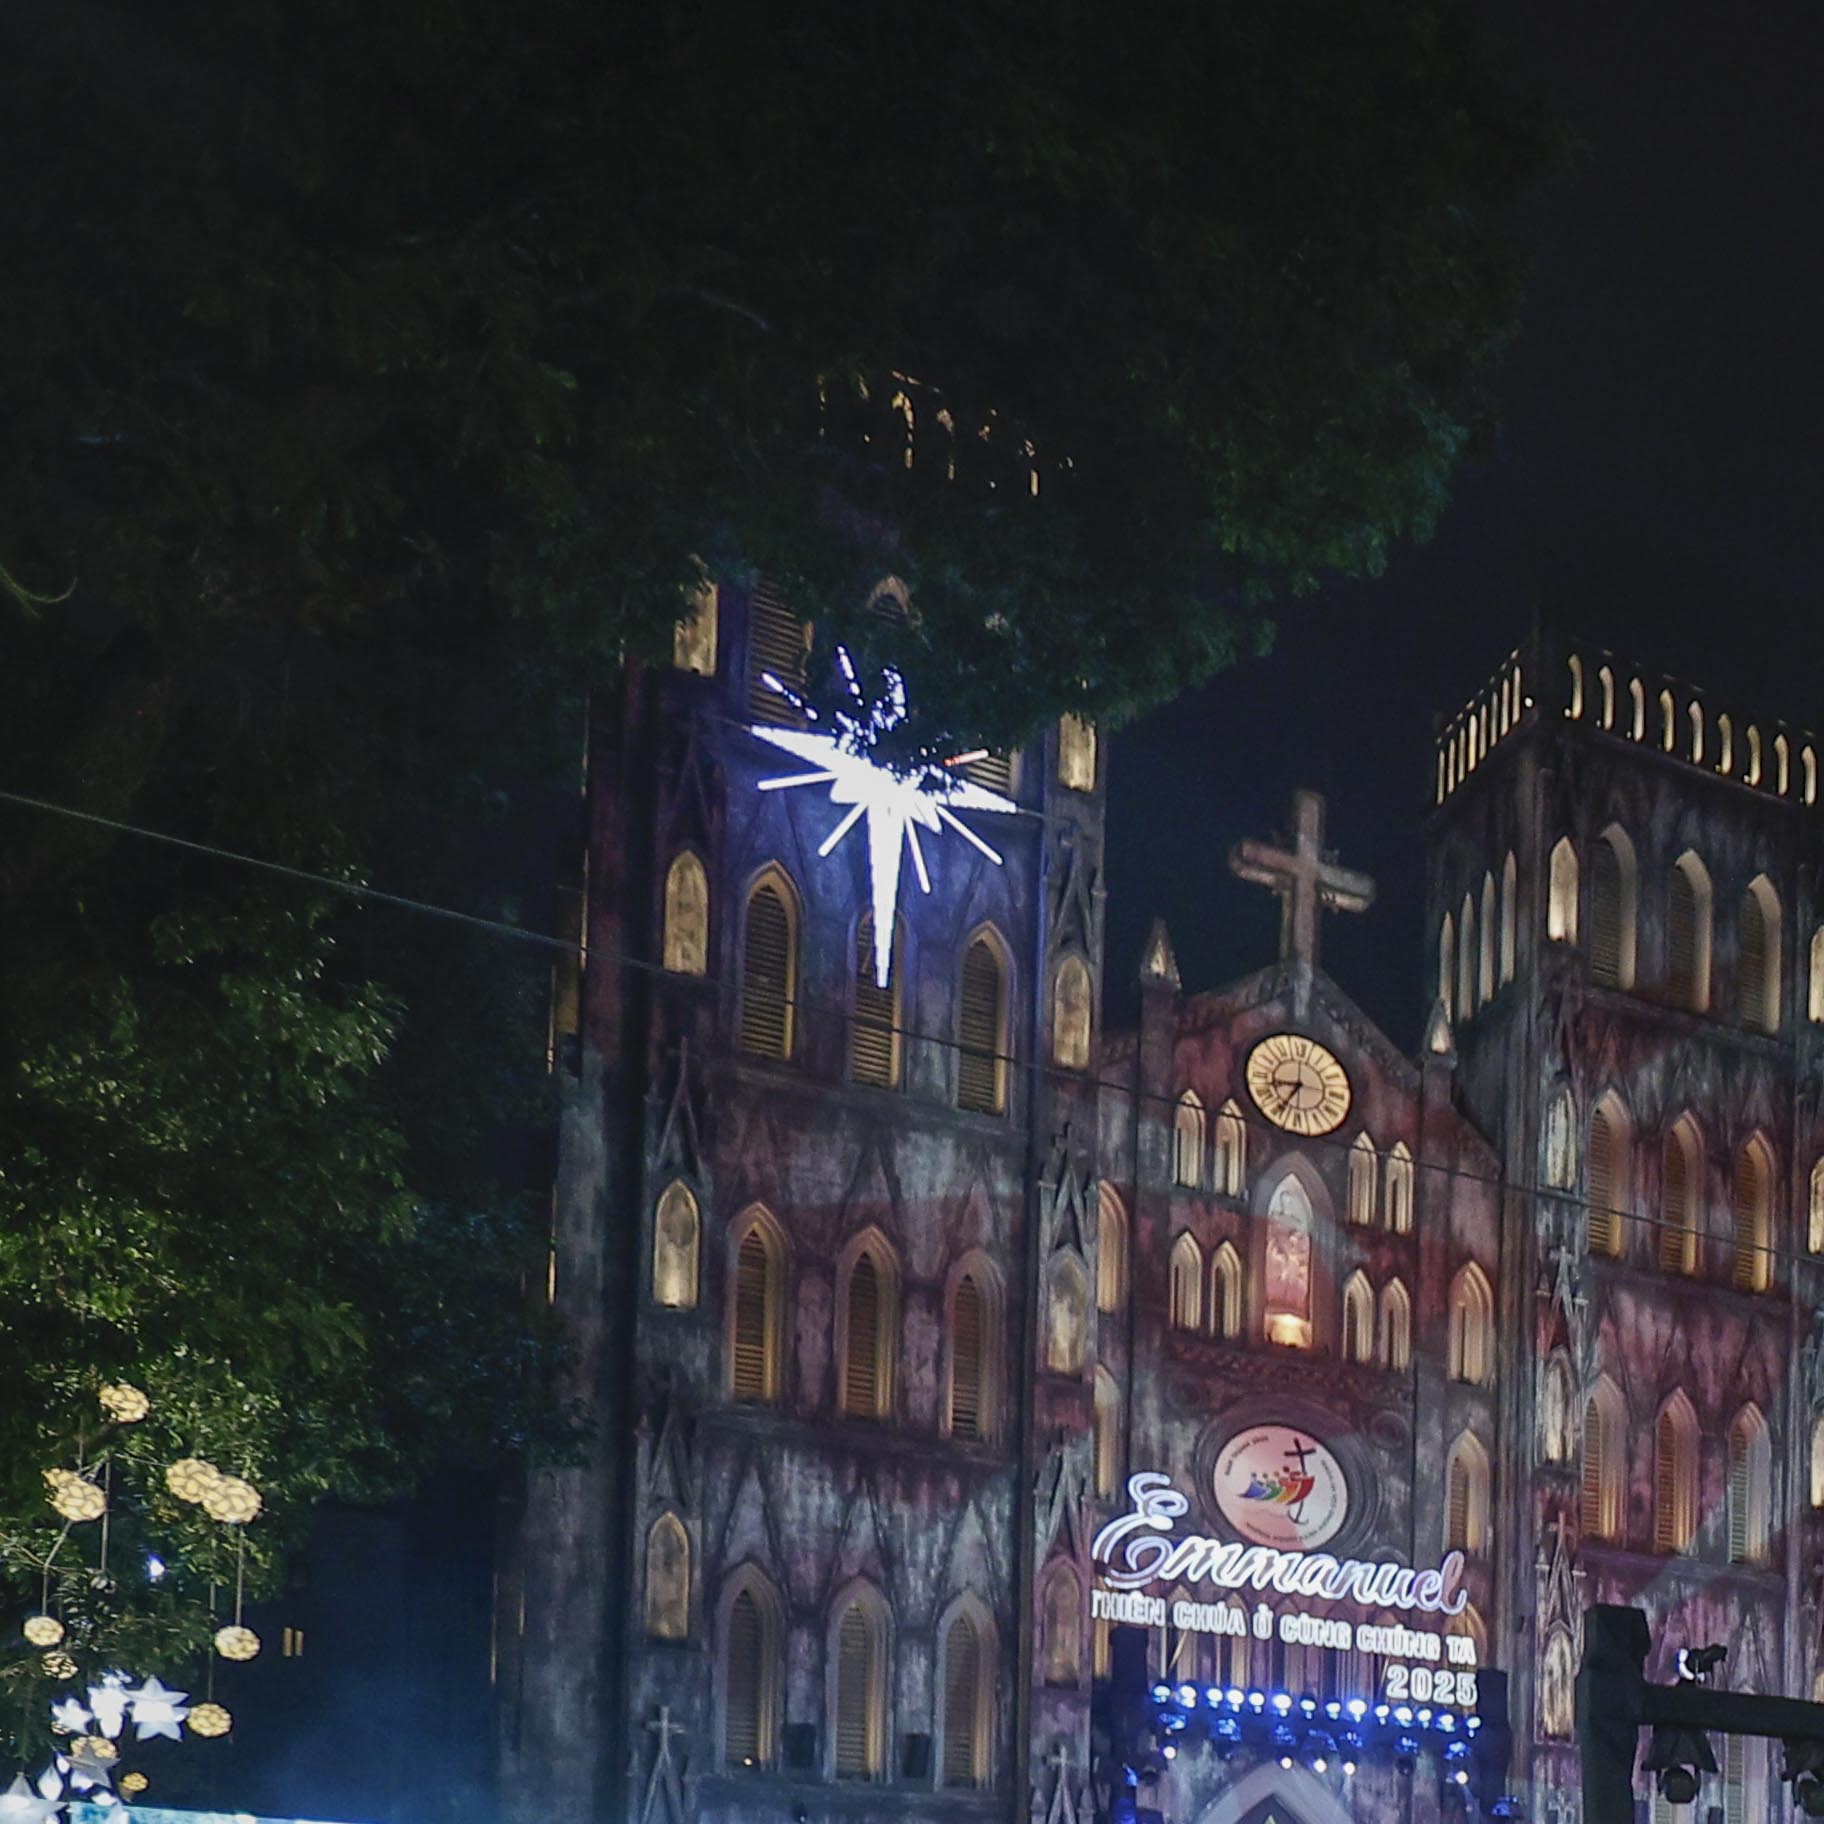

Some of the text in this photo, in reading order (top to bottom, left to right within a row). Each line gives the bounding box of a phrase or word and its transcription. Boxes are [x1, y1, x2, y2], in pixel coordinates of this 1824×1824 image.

[1092, 1472, 1468, 1614] Emmanuel
[1173, 1600, 1247, 1637] CHÚA
[1279, 1612, 1352, 1650] CÙNG
[1356, 1624, 1441, 1661] CHÚNG
[1446, 1635, 1477, 1665] TA
[1386, 1664, 1478, 1706] 2025
